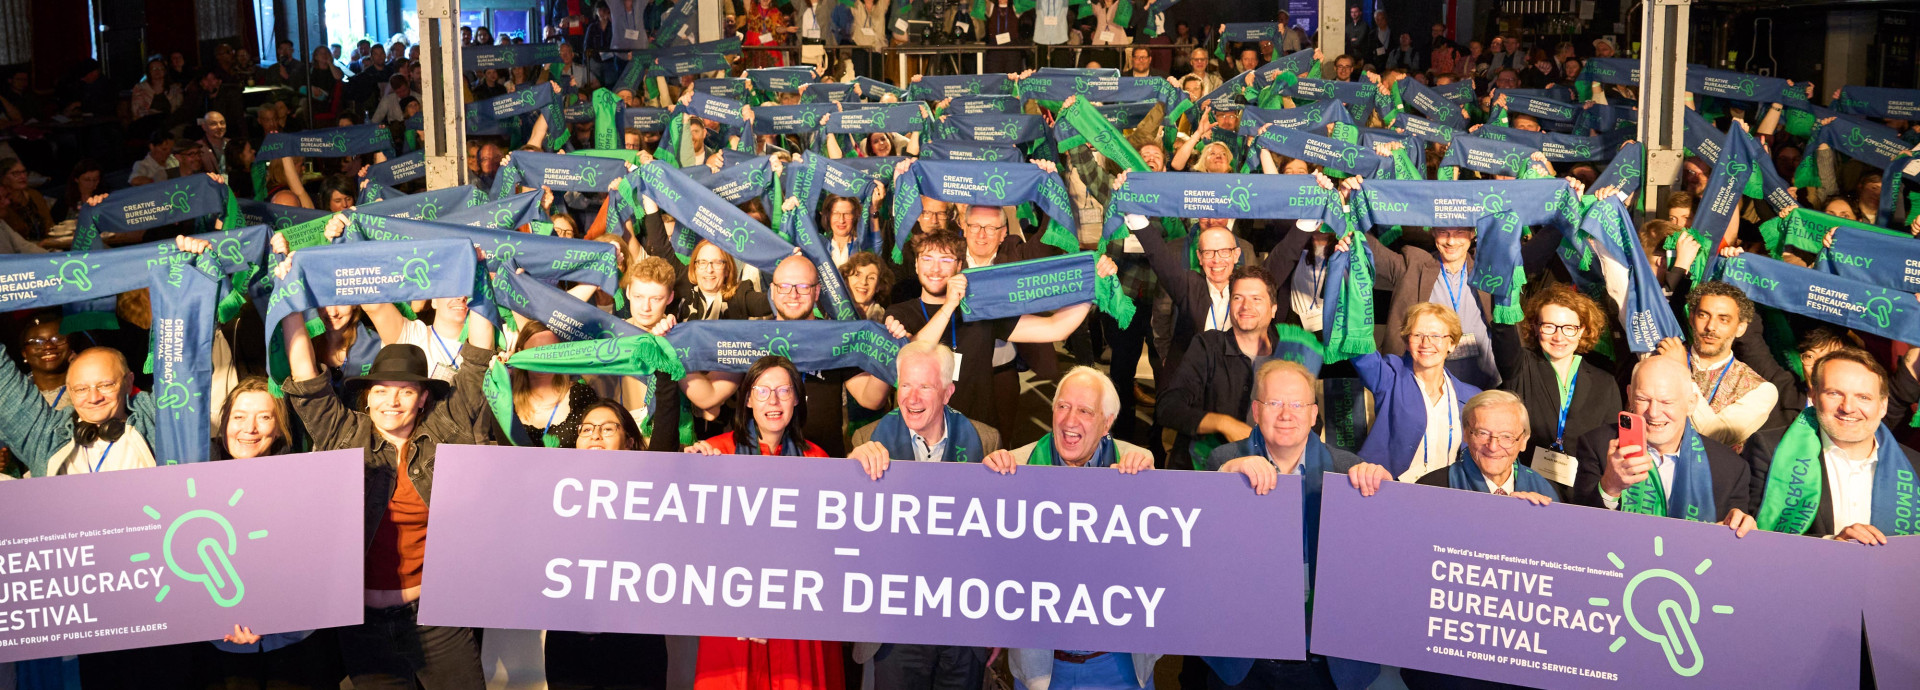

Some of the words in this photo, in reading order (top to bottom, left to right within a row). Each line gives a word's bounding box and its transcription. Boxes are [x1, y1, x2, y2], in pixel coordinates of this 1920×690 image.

[1704, 82, 1740, 90] BUREAUCRACY
[493, 98, 512, 106] CREATIVE
[1413, 99, 1428, 111] FESTIVAL
[1415, 95, 1439, 113] BUREAUCRACY
[1417, 92, 1434, 105] CREATIVE
[493, 100, 524, 111] BUREAUCRACY
[495, 107, 513, 115] FESTIVAL
[705, 104, 740, 116] BUREAUCRACY
[1528, 107, 1547, 115] FESTIVAL
[1529, 103, 1560, 113] BUREAUCRACY
[704, 110, 726, 118] FESTIVAL
[1407, 121, 1440, 133] BUREAUCRACY
[1408, 117, 1430, 126] CREATIVE
[1406, 126, 1426, 135] FESTIVAL
[1307, 139, 1332, 149] CREATIVE
[1304, 150, 1327, 161] FESTIVAL
[1305, 144, 1342, 158] BUREAUCRACY
[1469, 149, 1494, 158] CREATIVE
[391, 160, 413, 170] CREATIVE
[1467, 160, 1491, 168] FESTIVAL
[1468, 155, 1506, 165] BUREAUCRACY
[394, 171, 416, 180] FESTIVAL
[944, 175, 973, 183] CREATIVE
[712, 181, 737, 194] CREATIVE
[943, 182, 989, 191] BUREAUCRACY
[943, 189, 972, 197] FESTIVAL
[1712, 186, 1725, 212] CREATIVE
[1718, 175, 1736, 214] BUREAUCRACY
[124, 201, 155, 211] CREATIVE
[1722, 192, 1736, 216] FESTIVAL
[125, 205, 173, 219] BUREAUCRACY
[699, 206, 723, 225] CREATIVE
[127, 215, 157, 224] FESTIVAL
[695, 212, 732, 238] BUREAUCRACY
[692, 218, 715, 236] FESTIVAL
[336, 267, 381, 277] CREATIVE
[552, 260, 617, 279] DEMOCRACY
[822, 261, 840, 289] CREATIVE
[336, 275, 405, 286] BUREAUCRACY
[1017, 269, 1082, 288] STRONGER
[336, 286, 380, 295] FESTIVAL
[1009, 281, 1083, 302] DEMOCRACY
[1809, 285, 1849, 301] CREATIVE
[1806, 301, 1843, 316] FESTIVAL
[1808, 293, 1867, 313] BUREAUCRACY
[552, 310, 584, 329] CREATIVE
[1645, 309, 1660, 341] CREATIVE
[174, 318, 183, 362] CREATIVE
[841, 330, 900, 356] STRONGER
[716, 349, 771, 357] BUREAUCRACY
[833, 343, 893, 367] DEMOCRACY
[552, 477, 799, 529] CREATIVE
[816, 490, 1201, 548] BUREAUCRACY
[12, 535, 39, 544] Largest
[40, 532, 67, 542] Festival
[80, 529, 101, 537] Public
[102, 527, 124, 535] Sector
[126, 524, 162, 533] Innovation
[1433, 545, 1445, 553] The
[1447, 547, 1472, 557] World's
[1474, 551, 1499, 562] Largest
[1500, 554, 1527, 564] Festival
[1529, 558, 1538, 566] for
[1540, 560, 1561, 570] Public
[1563, 564, 1585, 573] Sector
[1587, 567, 1623, 578] Innovation
[1431, 560, 1554, 597] CREATIVE
[541, 558, 824, 612] STRONGER
[843, 572, 1166, 628] DEMOCRACY
[1429, 588, 1622, 636] BUREAUCRACY
[20, 635, 48, 644] FORUM
[63, 630, 92, 639] PUBLIC
[95, 627, 128, 636] SERVICE
[131, 623, 167, 632] LEADERS
[1427, 617, 1548, 654] FESTIVAL
[1433, 646, 1464, 658] GLOBAL
[1467, 651, 1496, 663] FORUM
[1497, 655, 1508, 663] OF
[1510, 657, 1540, 668] PUBLIC
[1542, 663, 1578, 675] SERVICE
[1579, 668, 1618, 681] LEADERS
